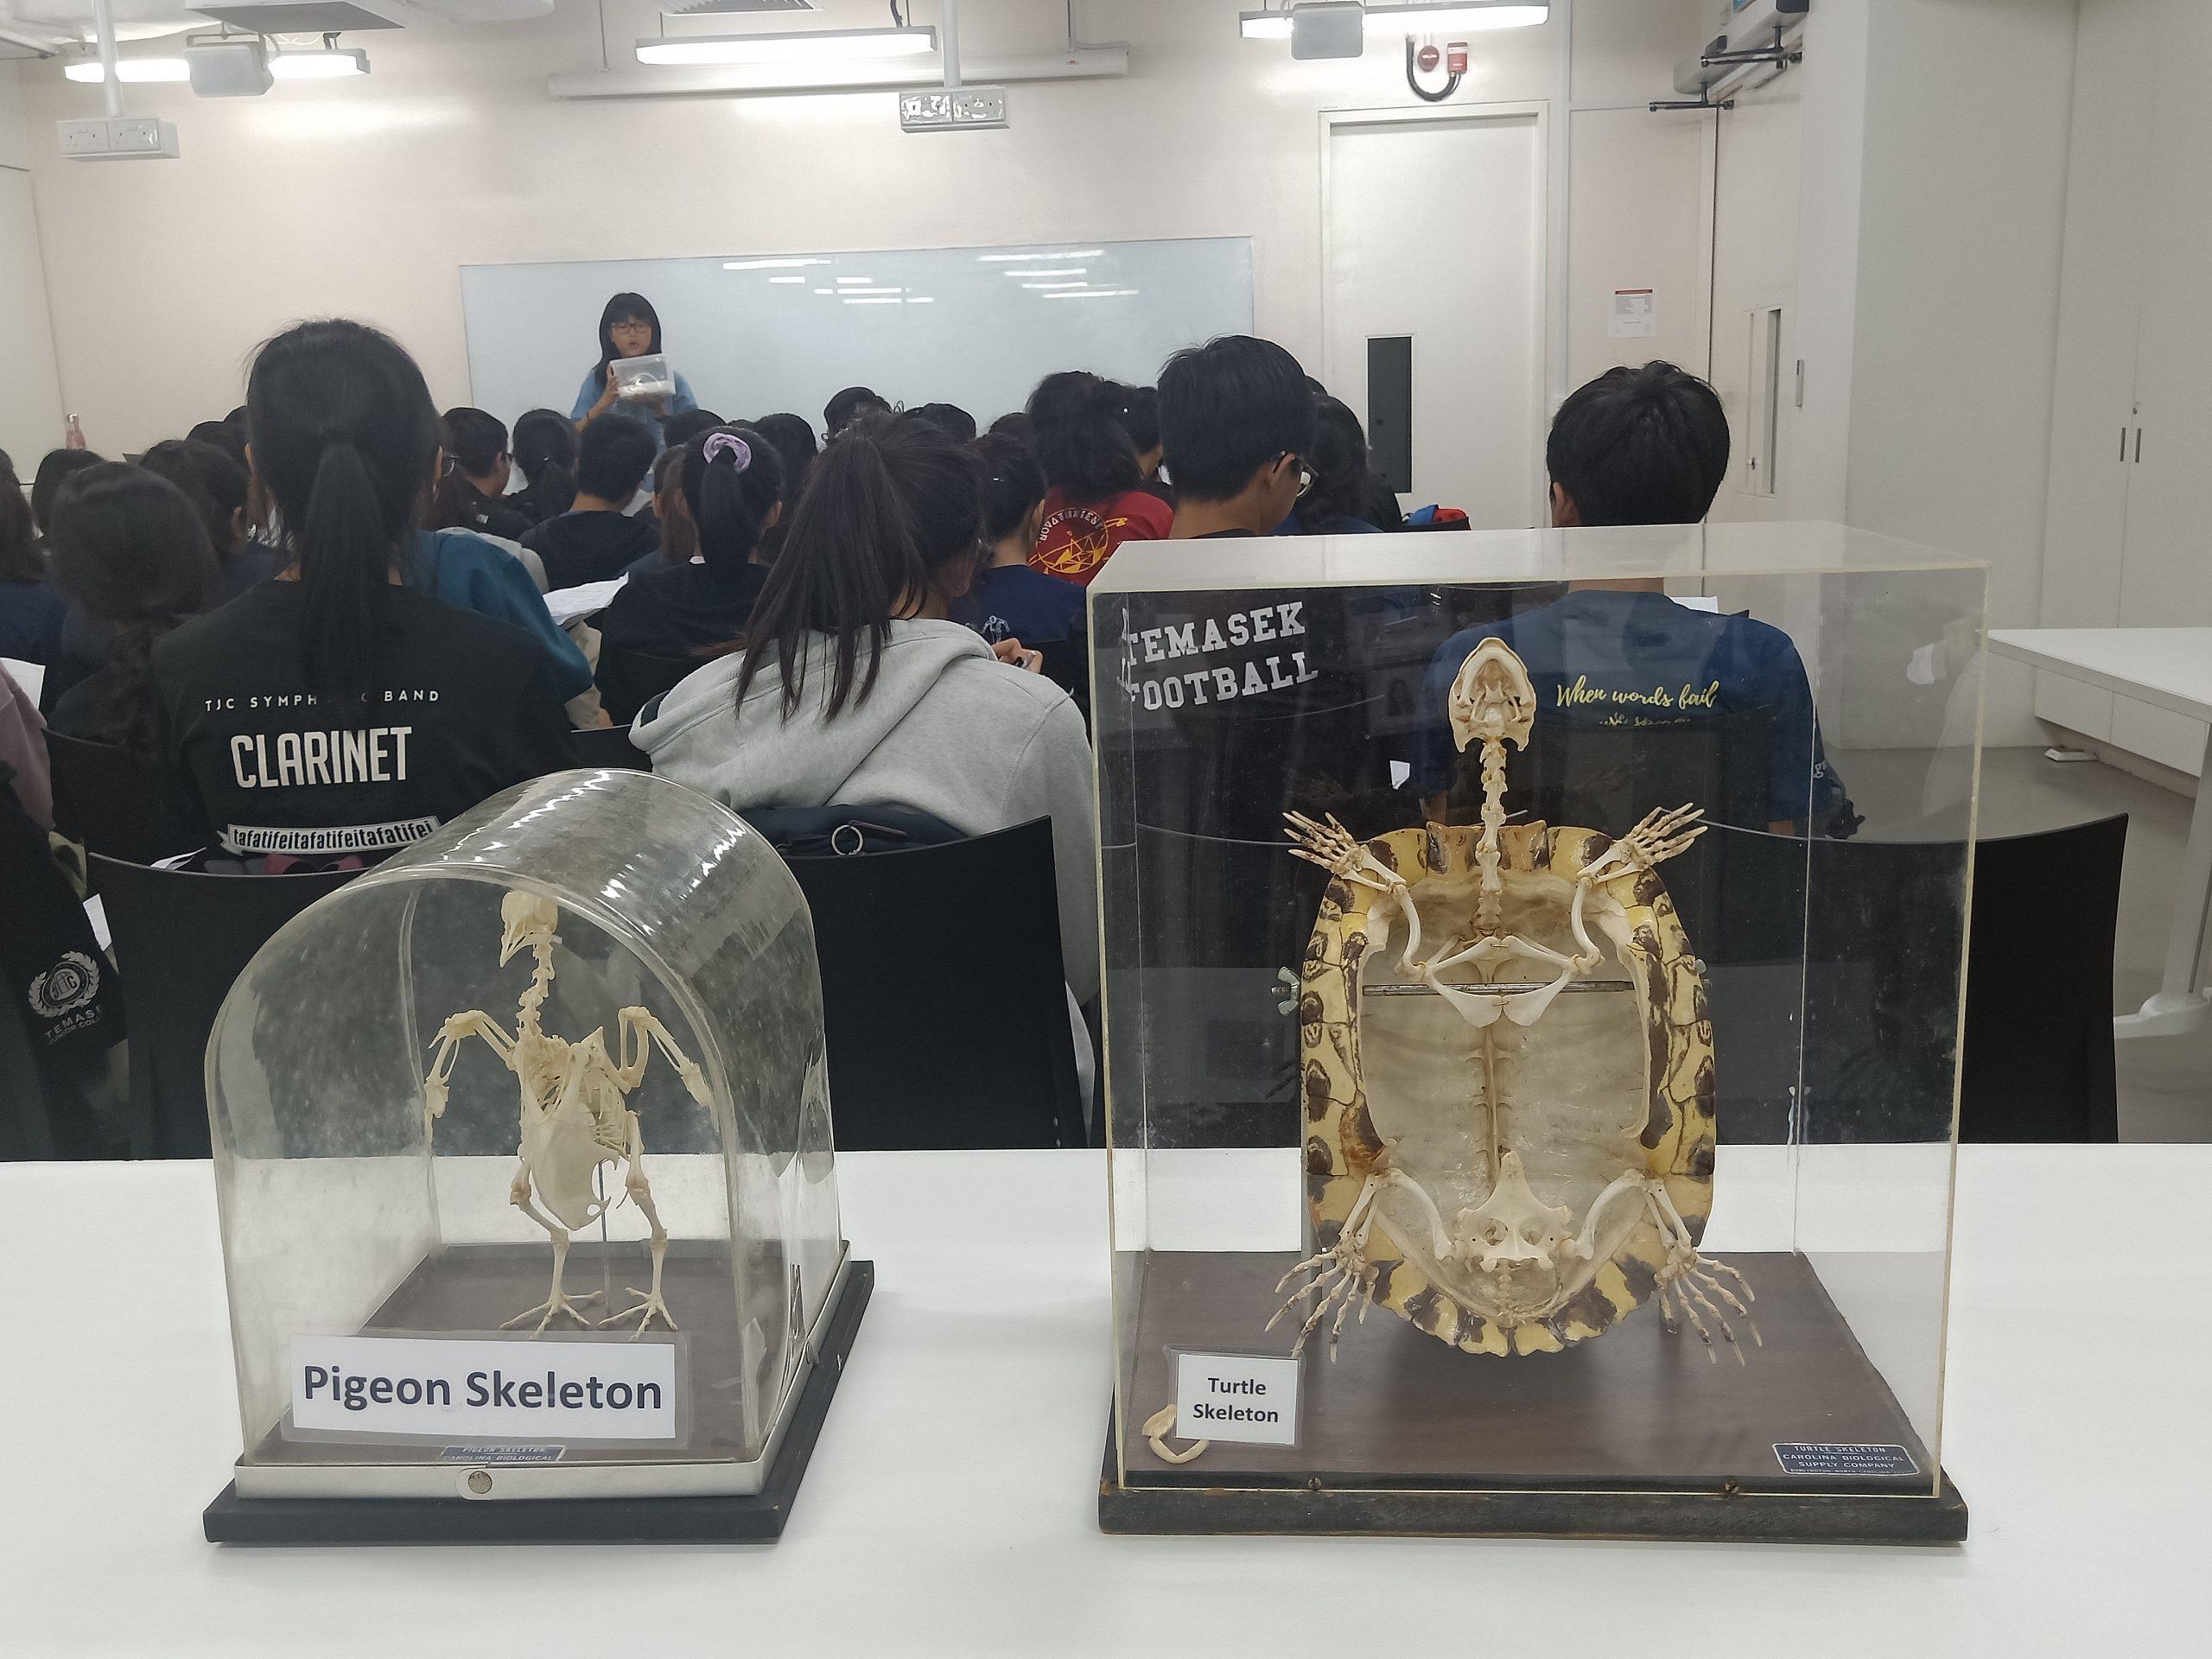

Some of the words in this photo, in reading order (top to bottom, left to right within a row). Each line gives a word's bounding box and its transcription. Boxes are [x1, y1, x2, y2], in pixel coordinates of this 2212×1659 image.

[1125, 601, 1306, 666] TEMASEK
[205, 698, 236, 712] TJC
[249, 692, 368, 709] SYMPHC
[384, 690, 440, 702] BAND
[1125, 651, 1319, 710] FOOTBALL
[1556, 674, 1607, 708] When
[1611, 686, 1674, 708] words
[1678, 680, 1720, 710] fail
[230, 726, 413, 789] CLARINET
[303, 1364, 451, 1411] Pigeon
[466, 1370, 663, 1410] Skeleton
[1207, 1377, 1267, 1395] Turtle
[1192, 1402, 1279, 1423] Skeleton
